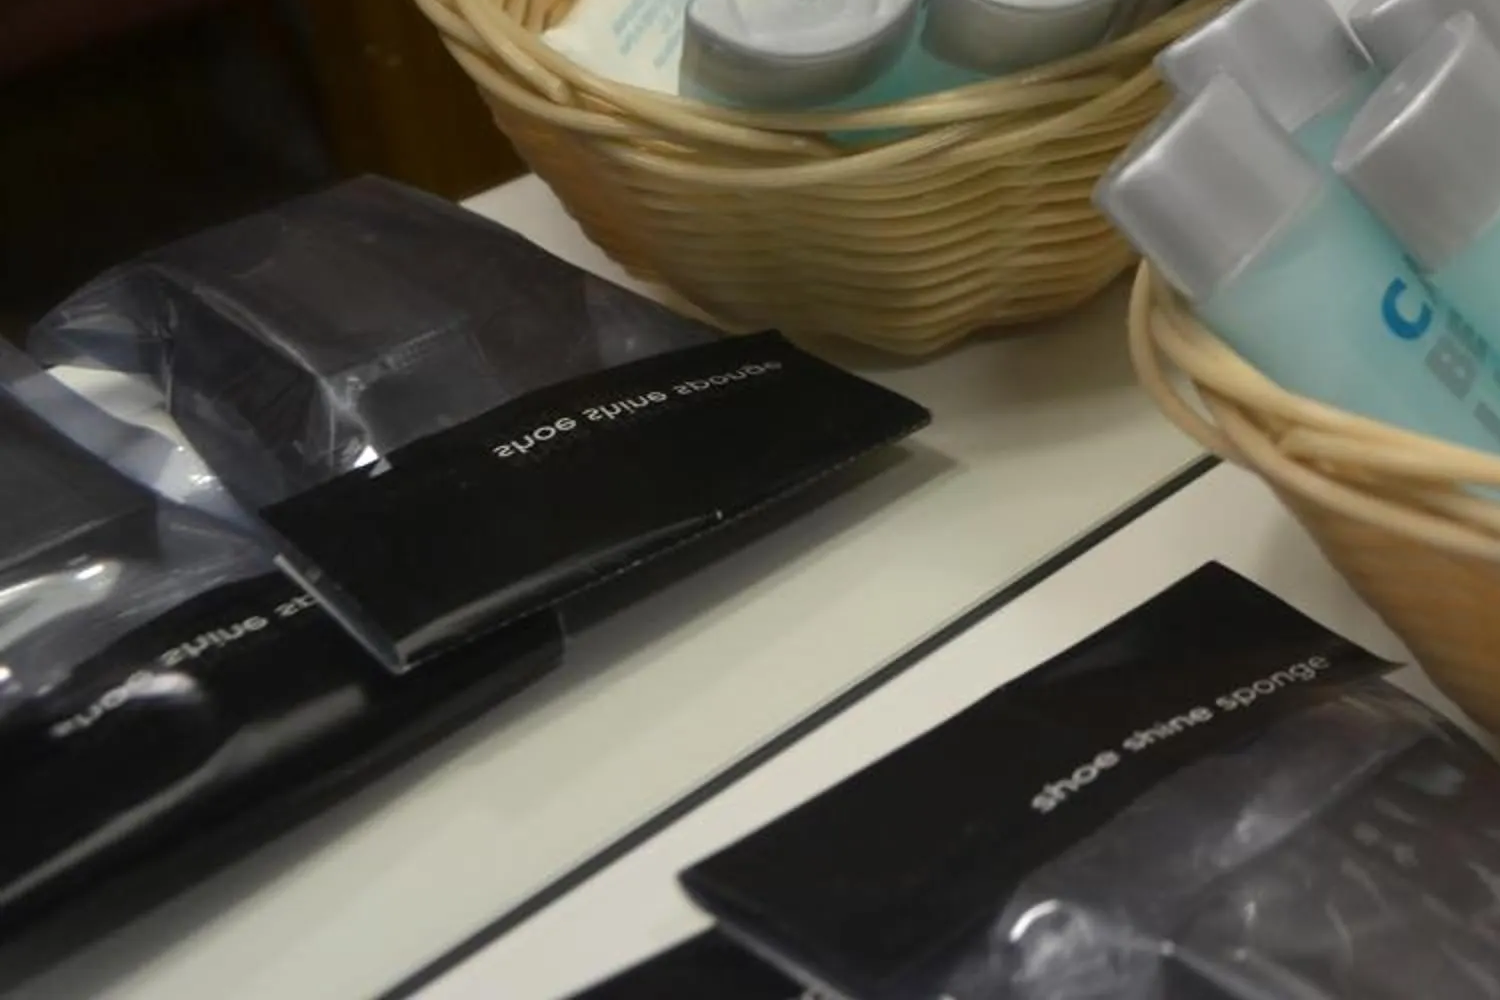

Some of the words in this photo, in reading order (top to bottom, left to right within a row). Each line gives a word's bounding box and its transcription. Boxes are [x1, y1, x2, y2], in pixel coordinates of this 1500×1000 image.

[1030, 749, 1120, 814] shoe
[1122, 705, 1214, 752] shine
[1215, 654, 1332, 709] sponge
